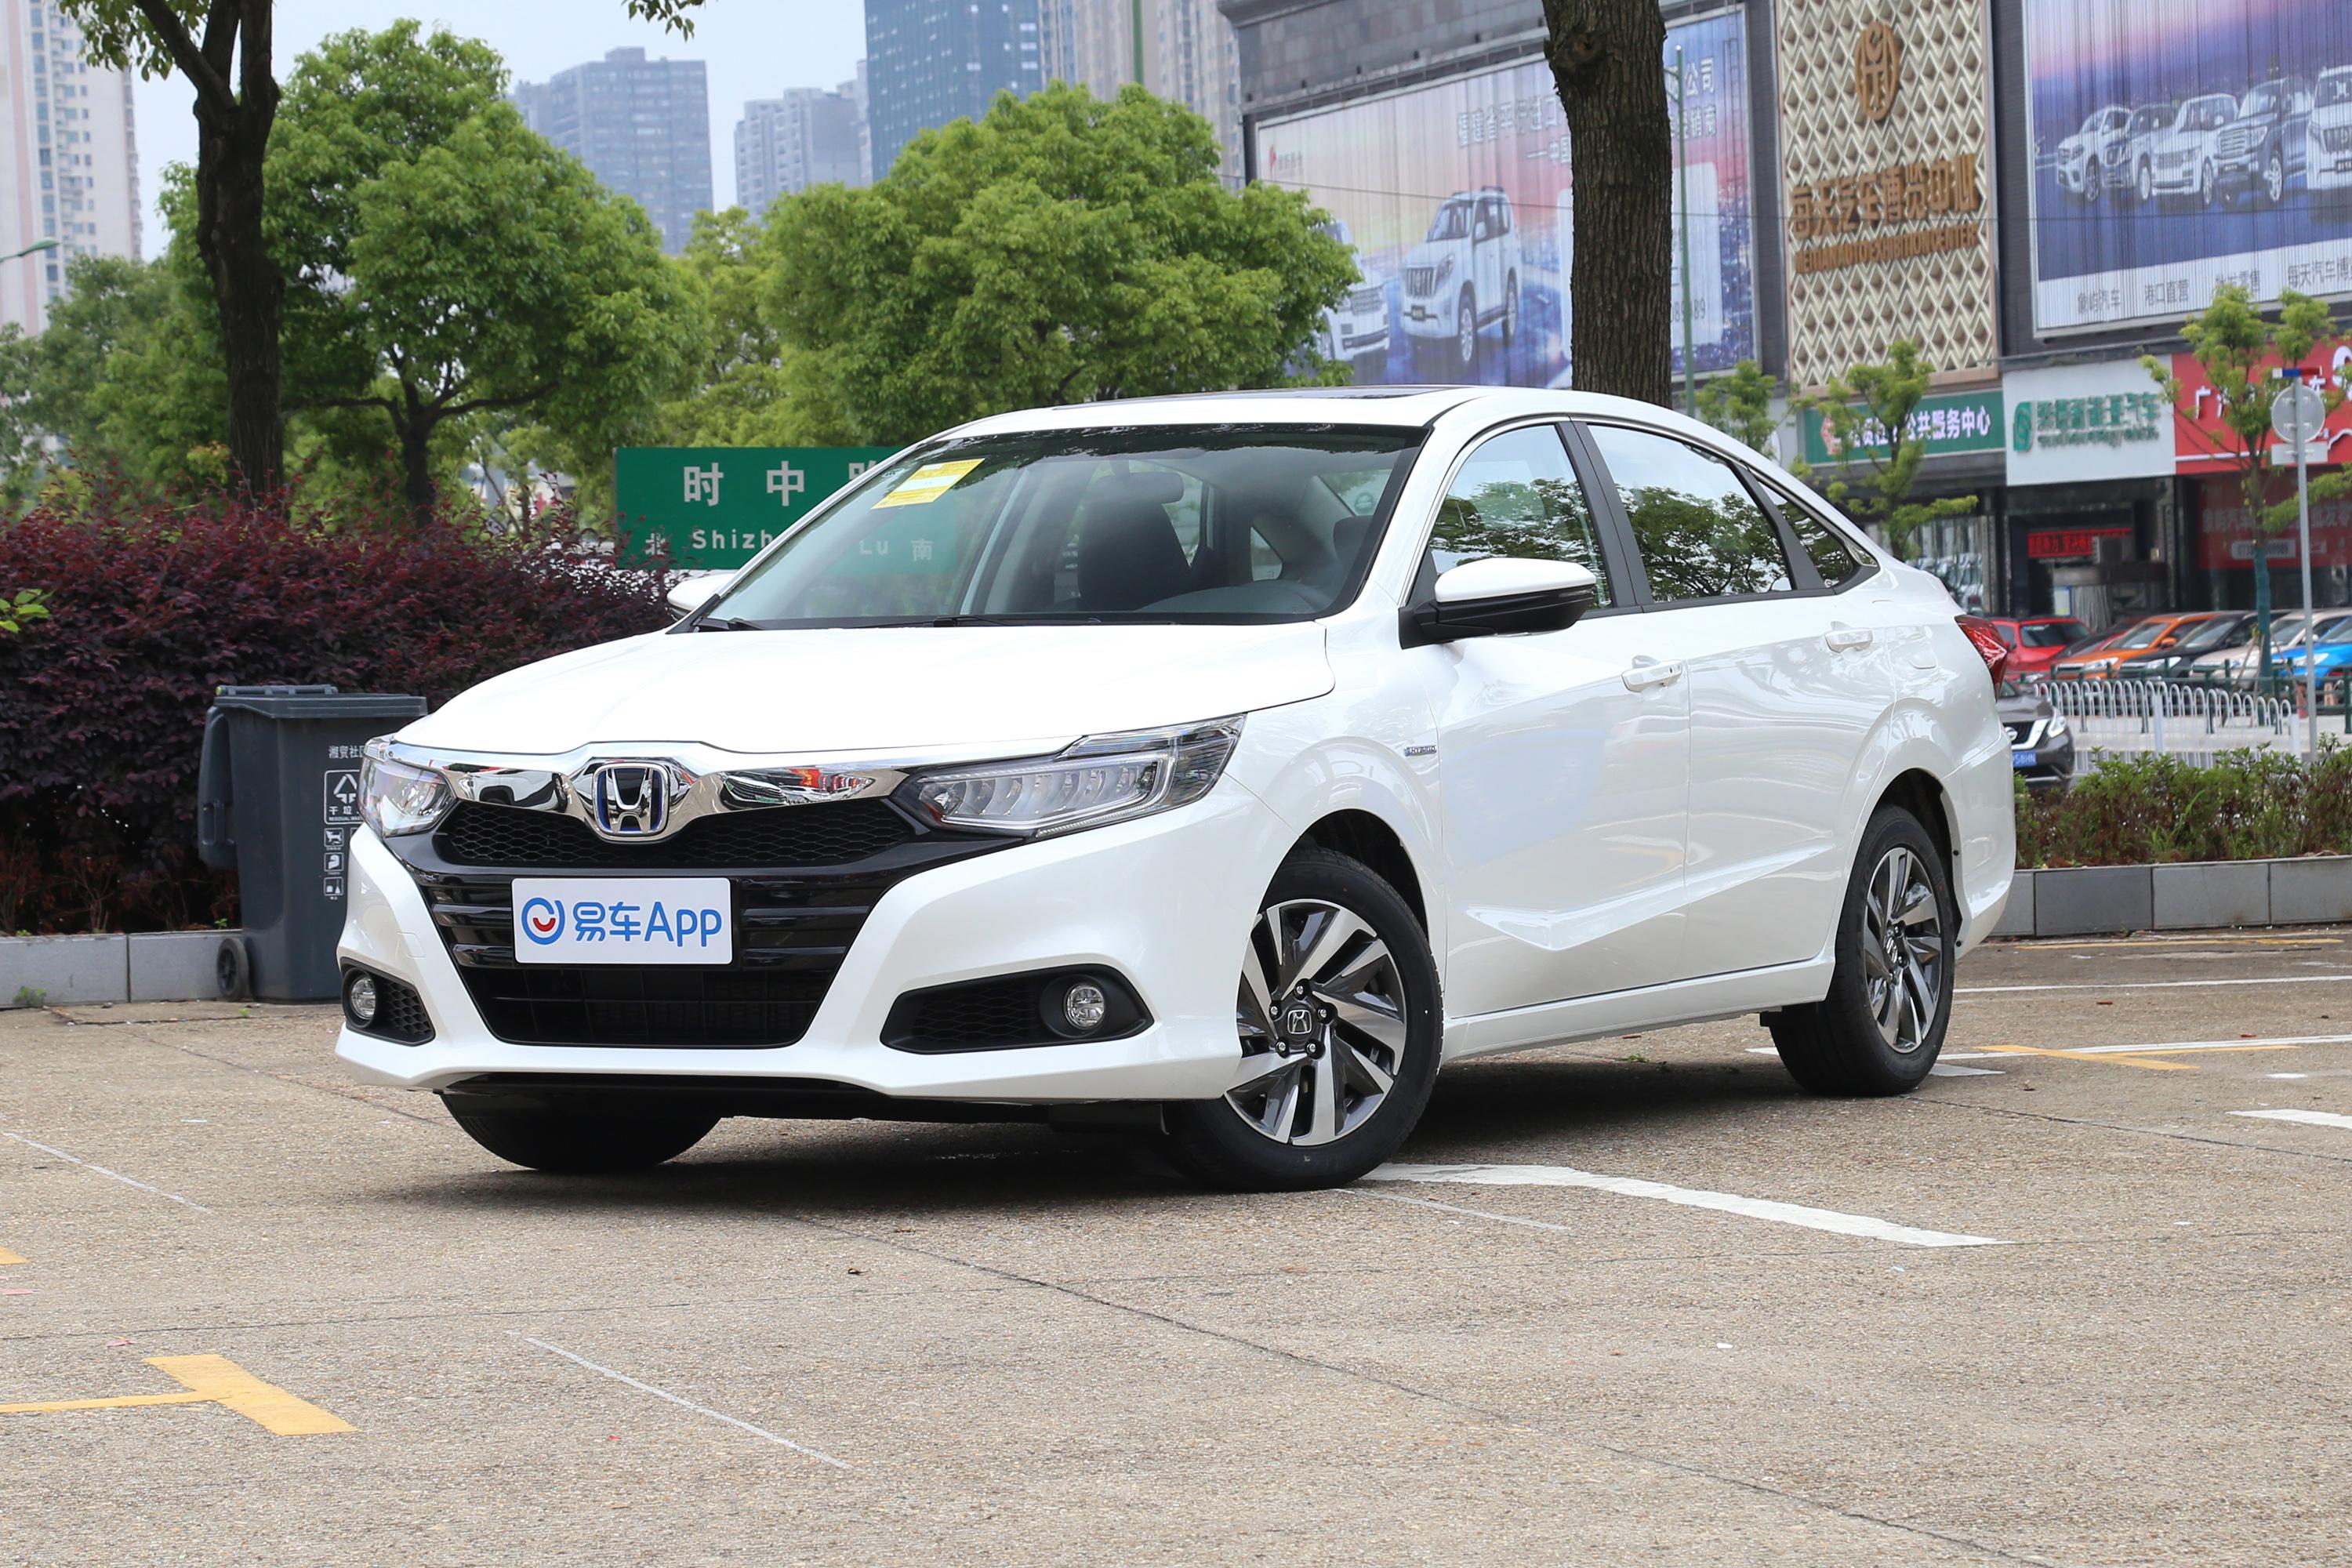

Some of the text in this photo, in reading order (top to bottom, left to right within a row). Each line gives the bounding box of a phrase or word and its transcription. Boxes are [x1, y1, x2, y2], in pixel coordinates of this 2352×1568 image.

[1791, 153, 1977, 239] 每天汽车博览中心
[1869, 230, 1930, 264] EXHIBITION
[2287, 254, 2352, 289] 每天汽车博
[692, 528, 889, 555] Shizh Lu
[910, 538, 934, 561] 南
[328, 806, 361, 816] 干垃
[573, 900, 722, 948] 易车App
